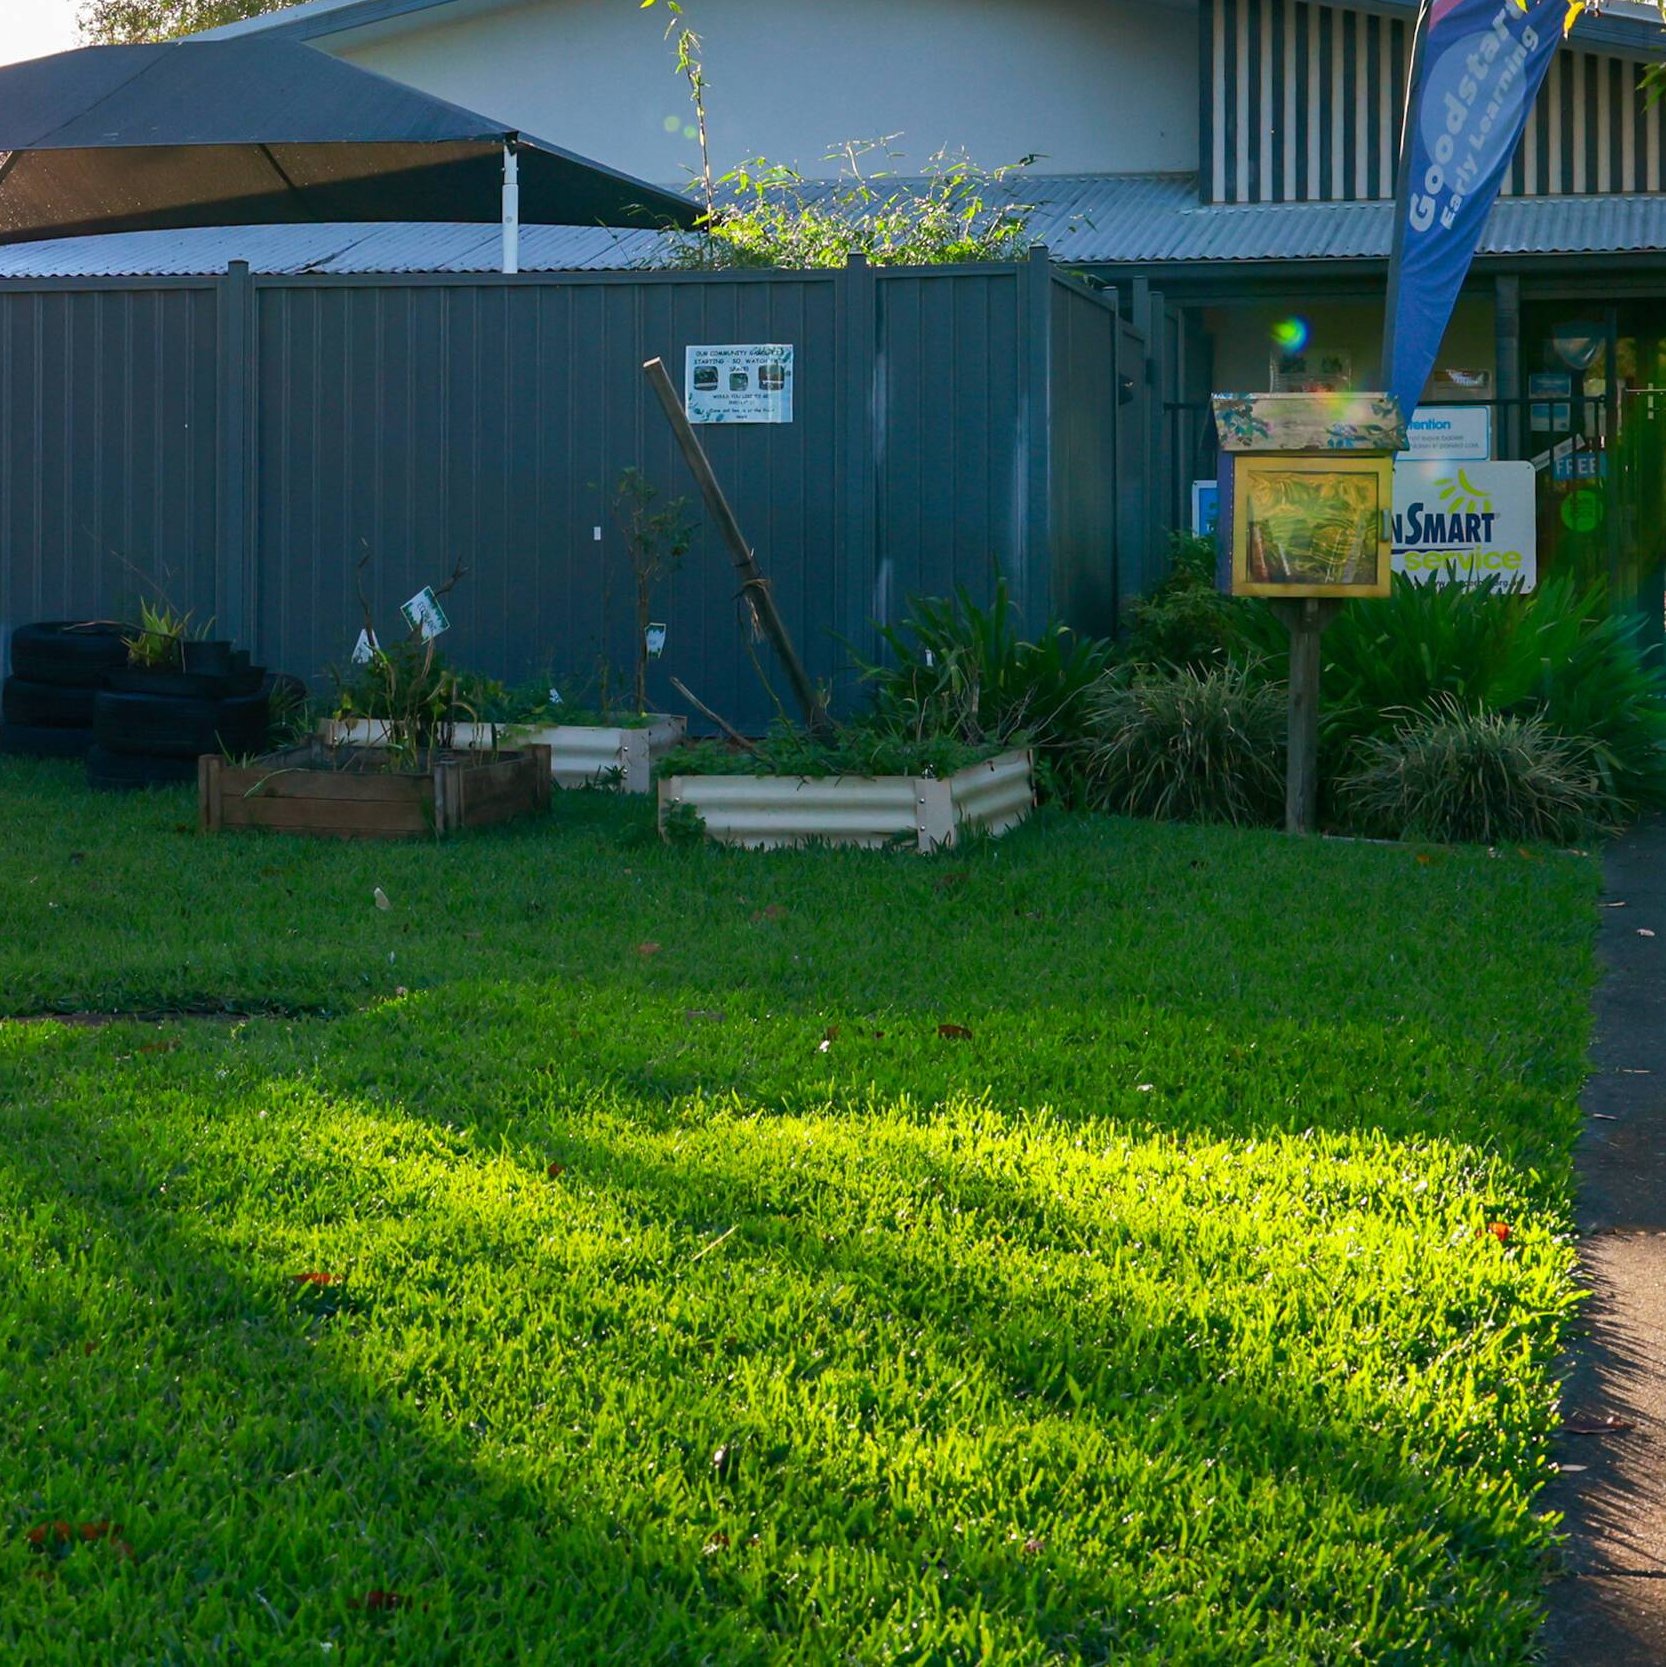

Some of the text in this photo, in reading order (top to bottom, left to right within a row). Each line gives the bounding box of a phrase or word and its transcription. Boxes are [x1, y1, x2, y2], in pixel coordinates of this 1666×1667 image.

[1440, 25, 1539, 230] Early Learning
[1555, 458, 1596, 475] FREE
[1391, 502, 1496, 545] NSMART
[1405, 545, 1523, 571] service
